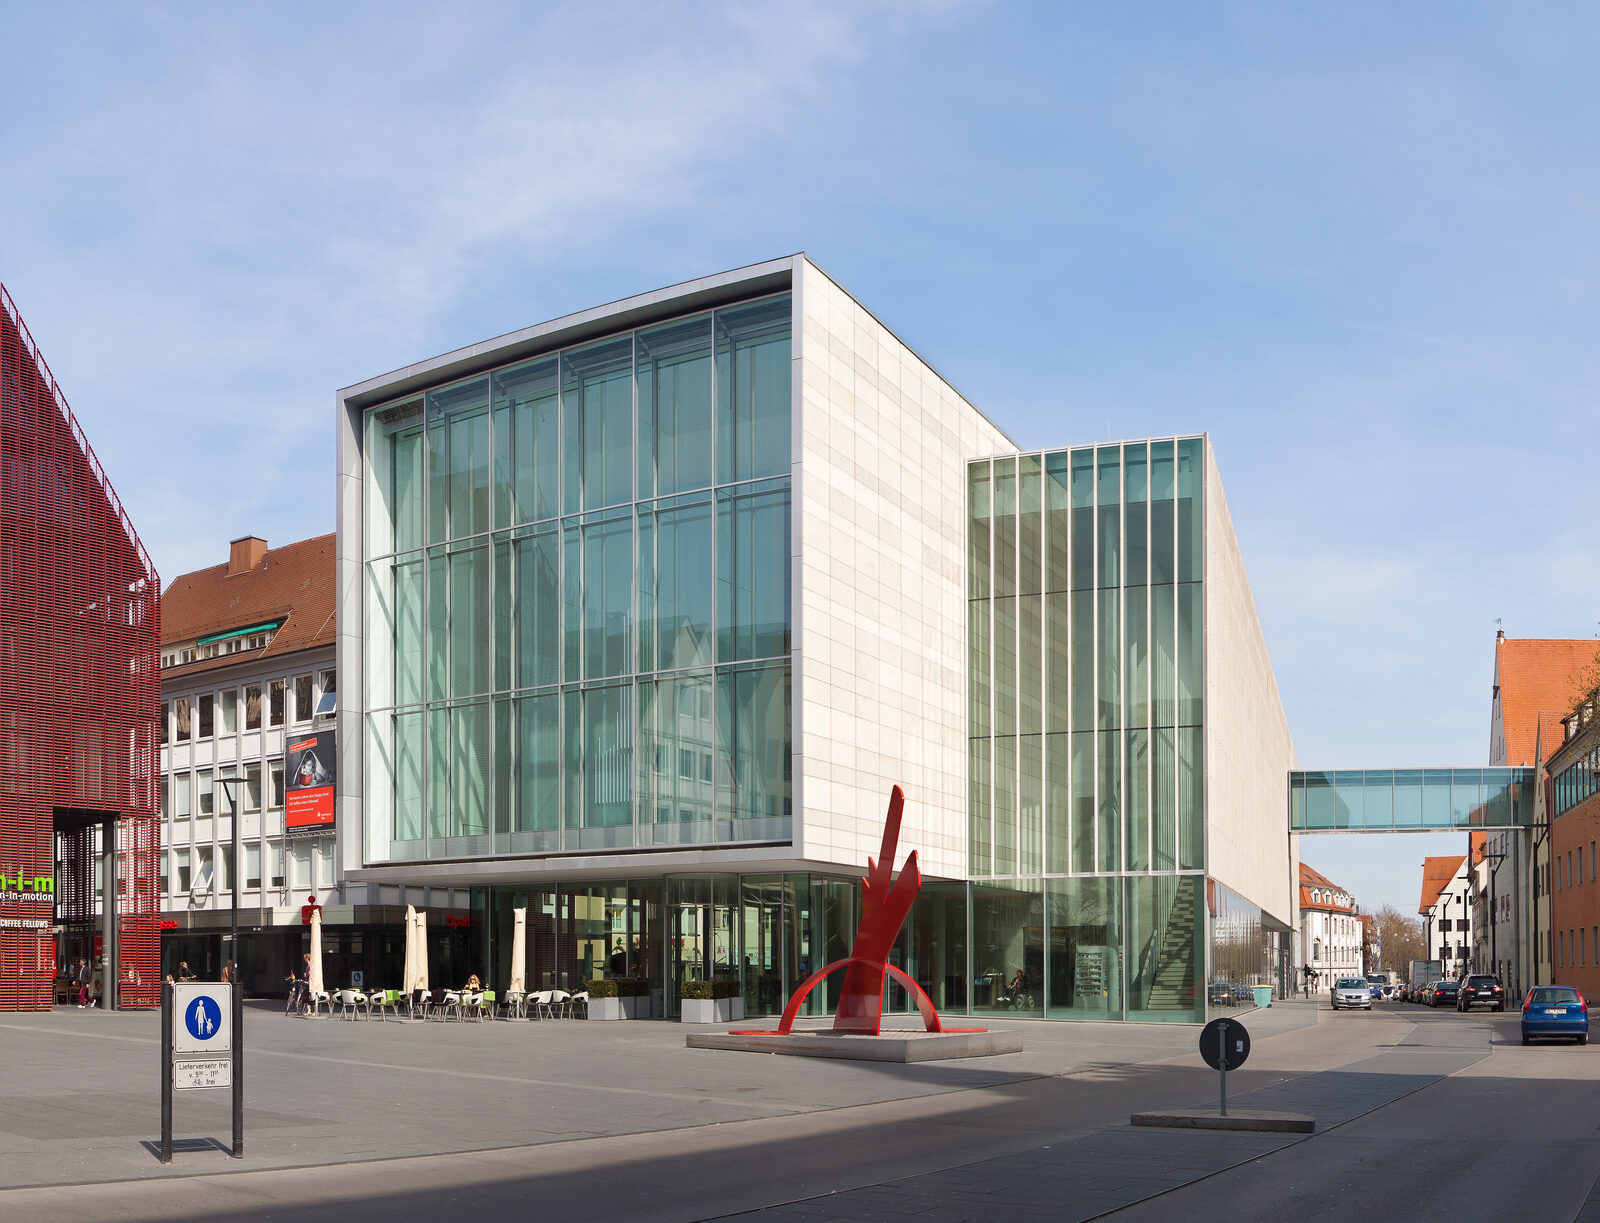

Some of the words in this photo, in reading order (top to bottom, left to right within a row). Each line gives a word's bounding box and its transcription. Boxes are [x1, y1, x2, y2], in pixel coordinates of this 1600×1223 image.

[1, 919, 22, 928] COFFEE
[23, 920, 49, 929] FELLOWS
[179, 1062, 217, 1070] Lieferverkehr
